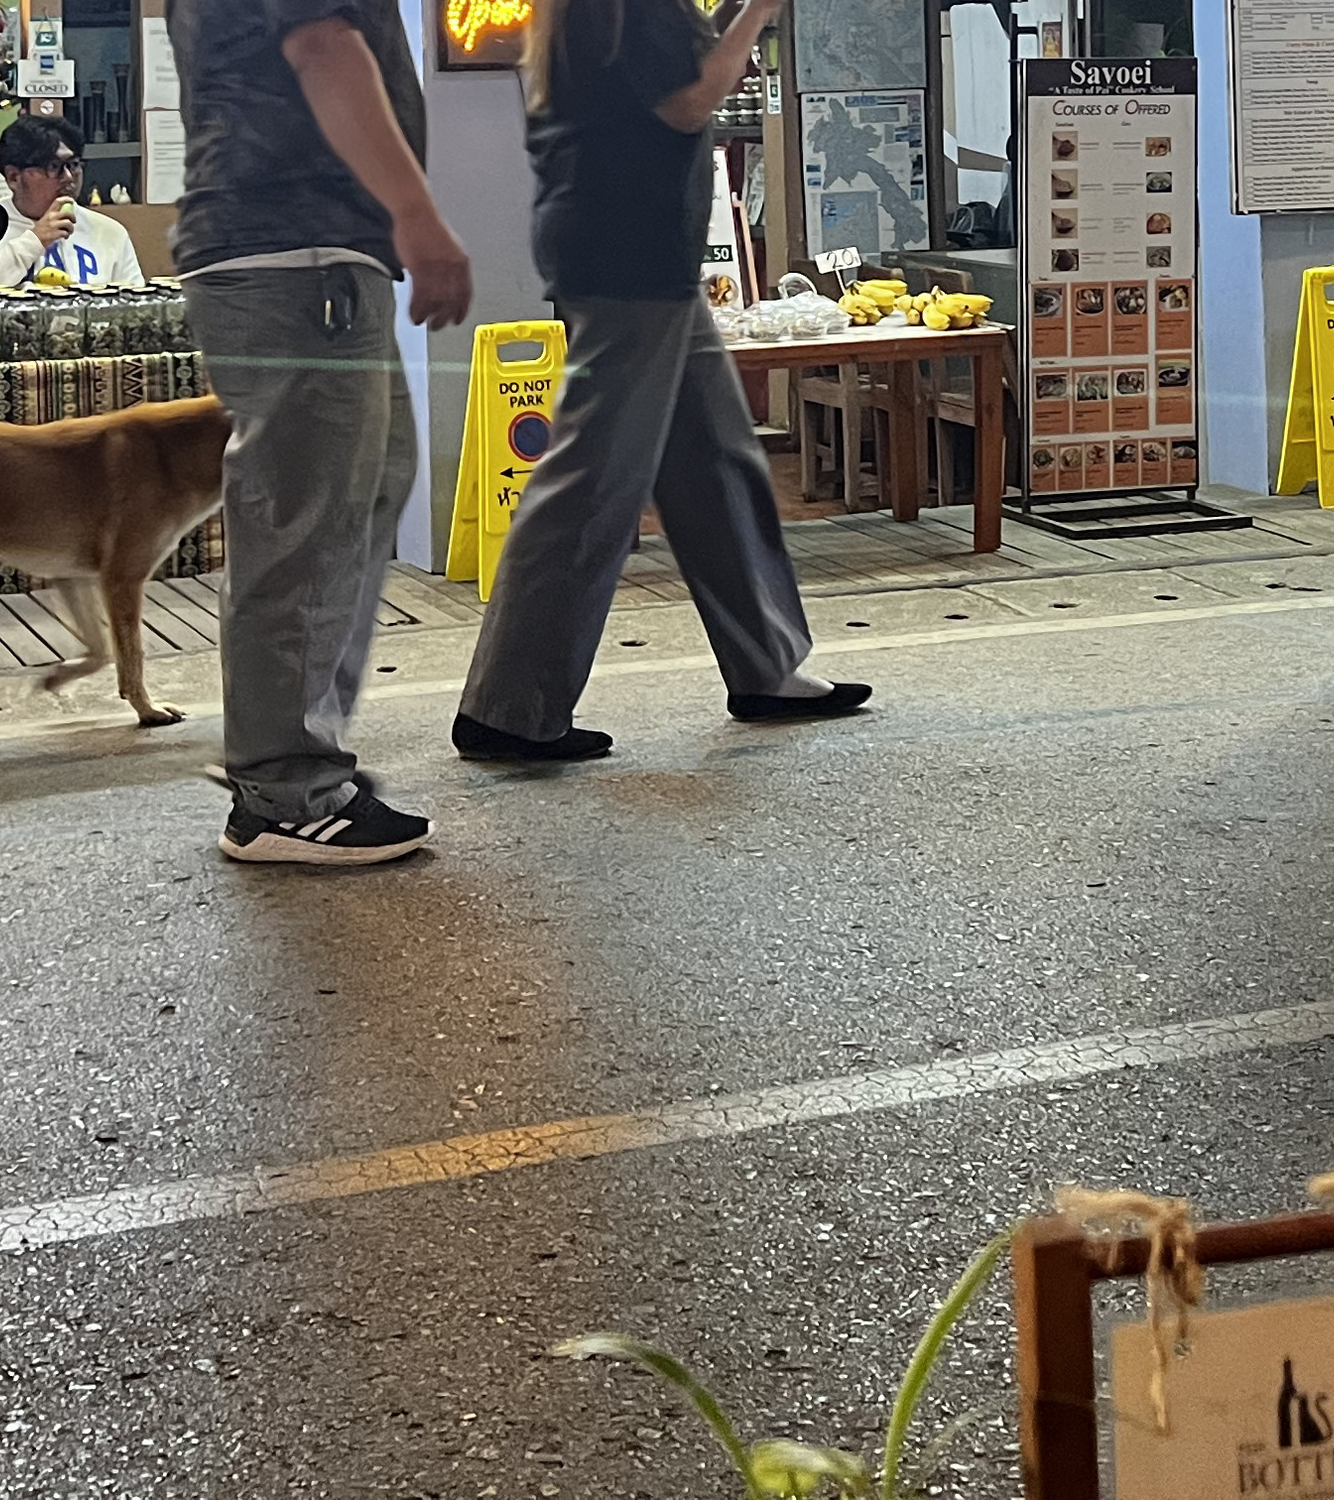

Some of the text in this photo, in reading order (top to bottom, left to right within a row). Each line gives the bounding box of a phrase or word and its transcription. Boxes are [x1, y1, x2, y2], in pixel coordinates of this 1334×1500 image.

[1071, 60, 1152, 84] Savoei
[25, 84, 68, 93] CLOSED
[1063, 86, 1084, 94] Taste
[1150, 85, 1175, 93] School
[1053, 100, 1171, 115] COURSES OF OFFERED
[713, 247, 729, 260] 50
[25, 242, 99, 284] AP
[499, 380, 552, 394] DO NOT
[510, 394, 544, 408] PARK
